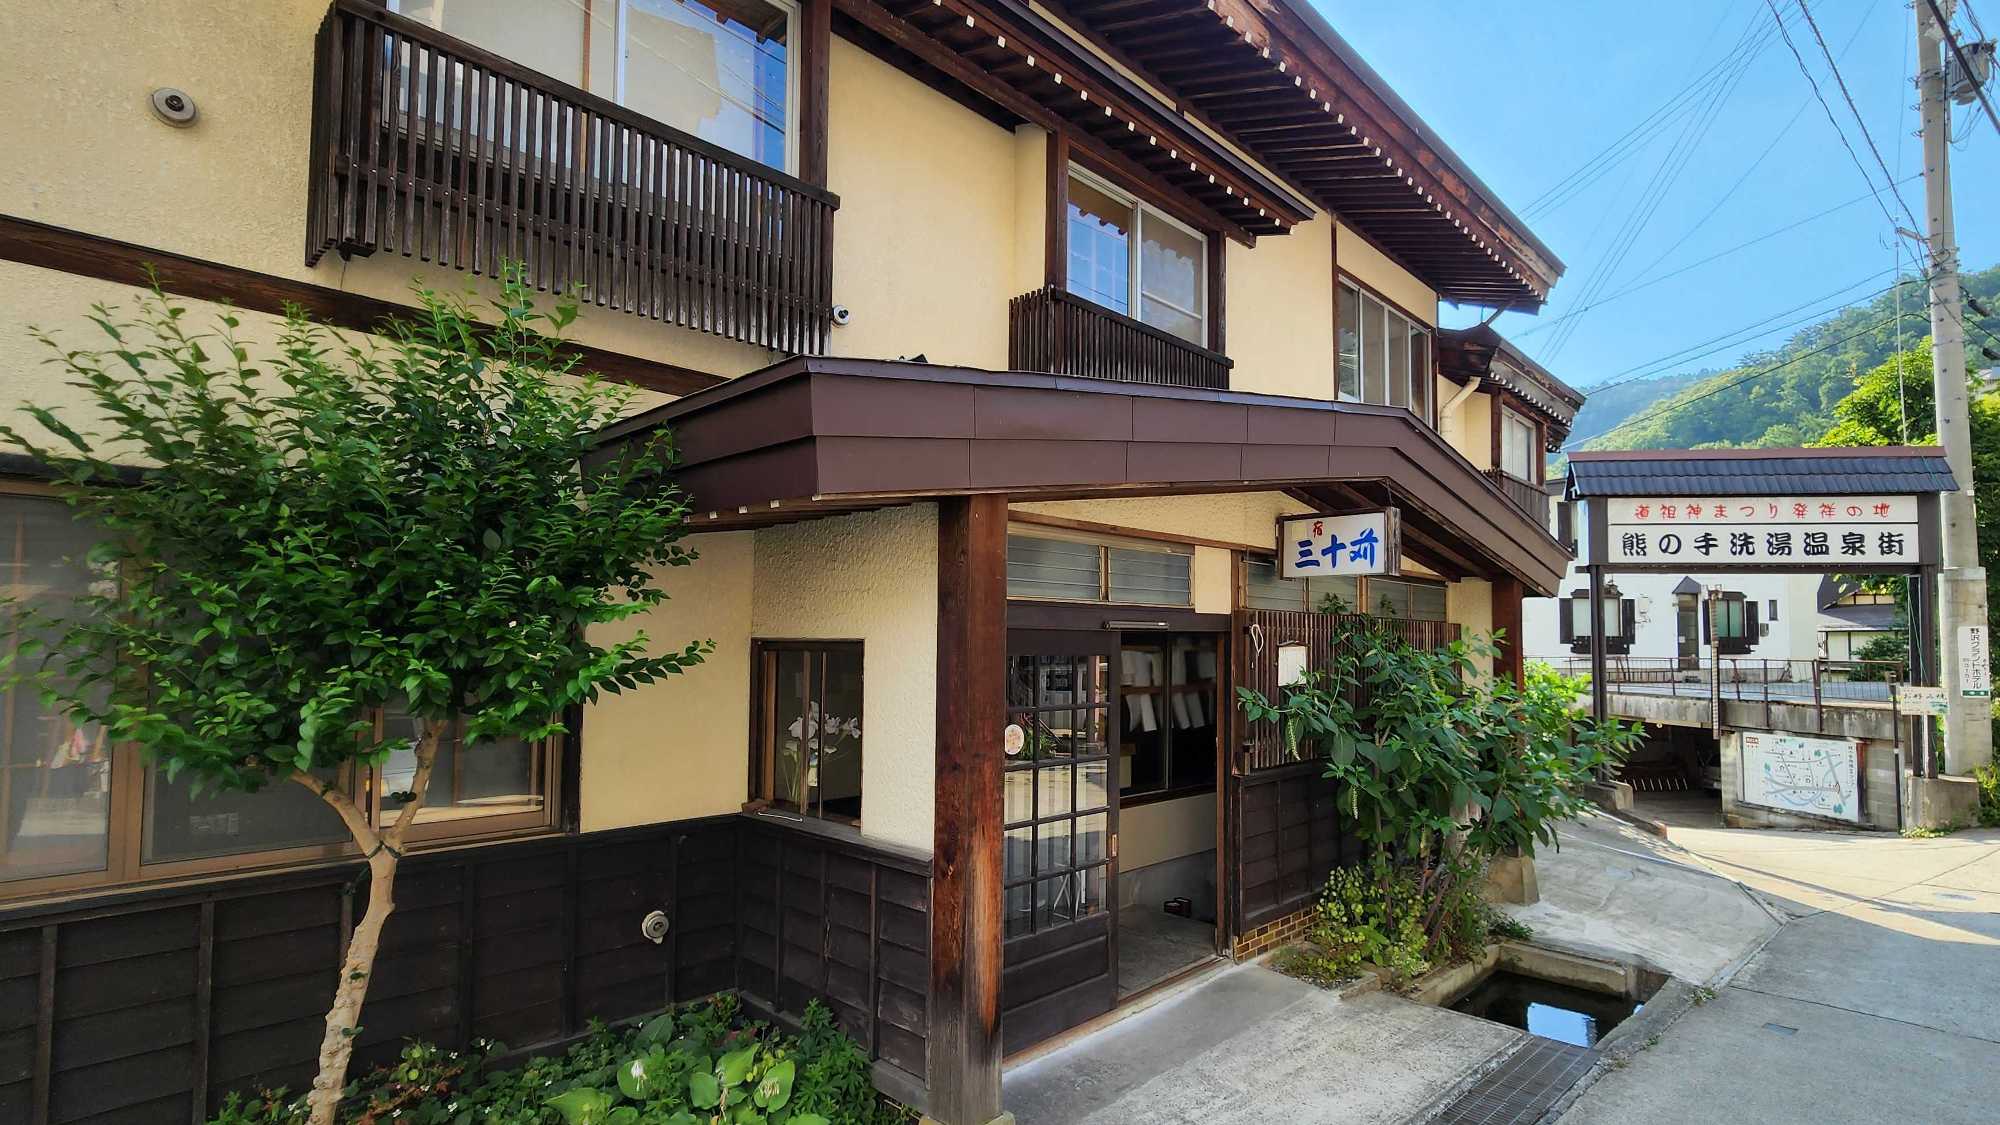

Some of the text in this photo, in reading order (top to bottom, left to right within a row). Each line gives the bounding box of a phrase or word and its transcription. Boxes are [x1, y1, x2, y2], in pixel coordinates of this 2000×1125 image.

[1634, 502, 1891, 520] 道祖神まつり発祥の地
[1621, 532, 1905, 557] 熊の手洗湯温泉街
